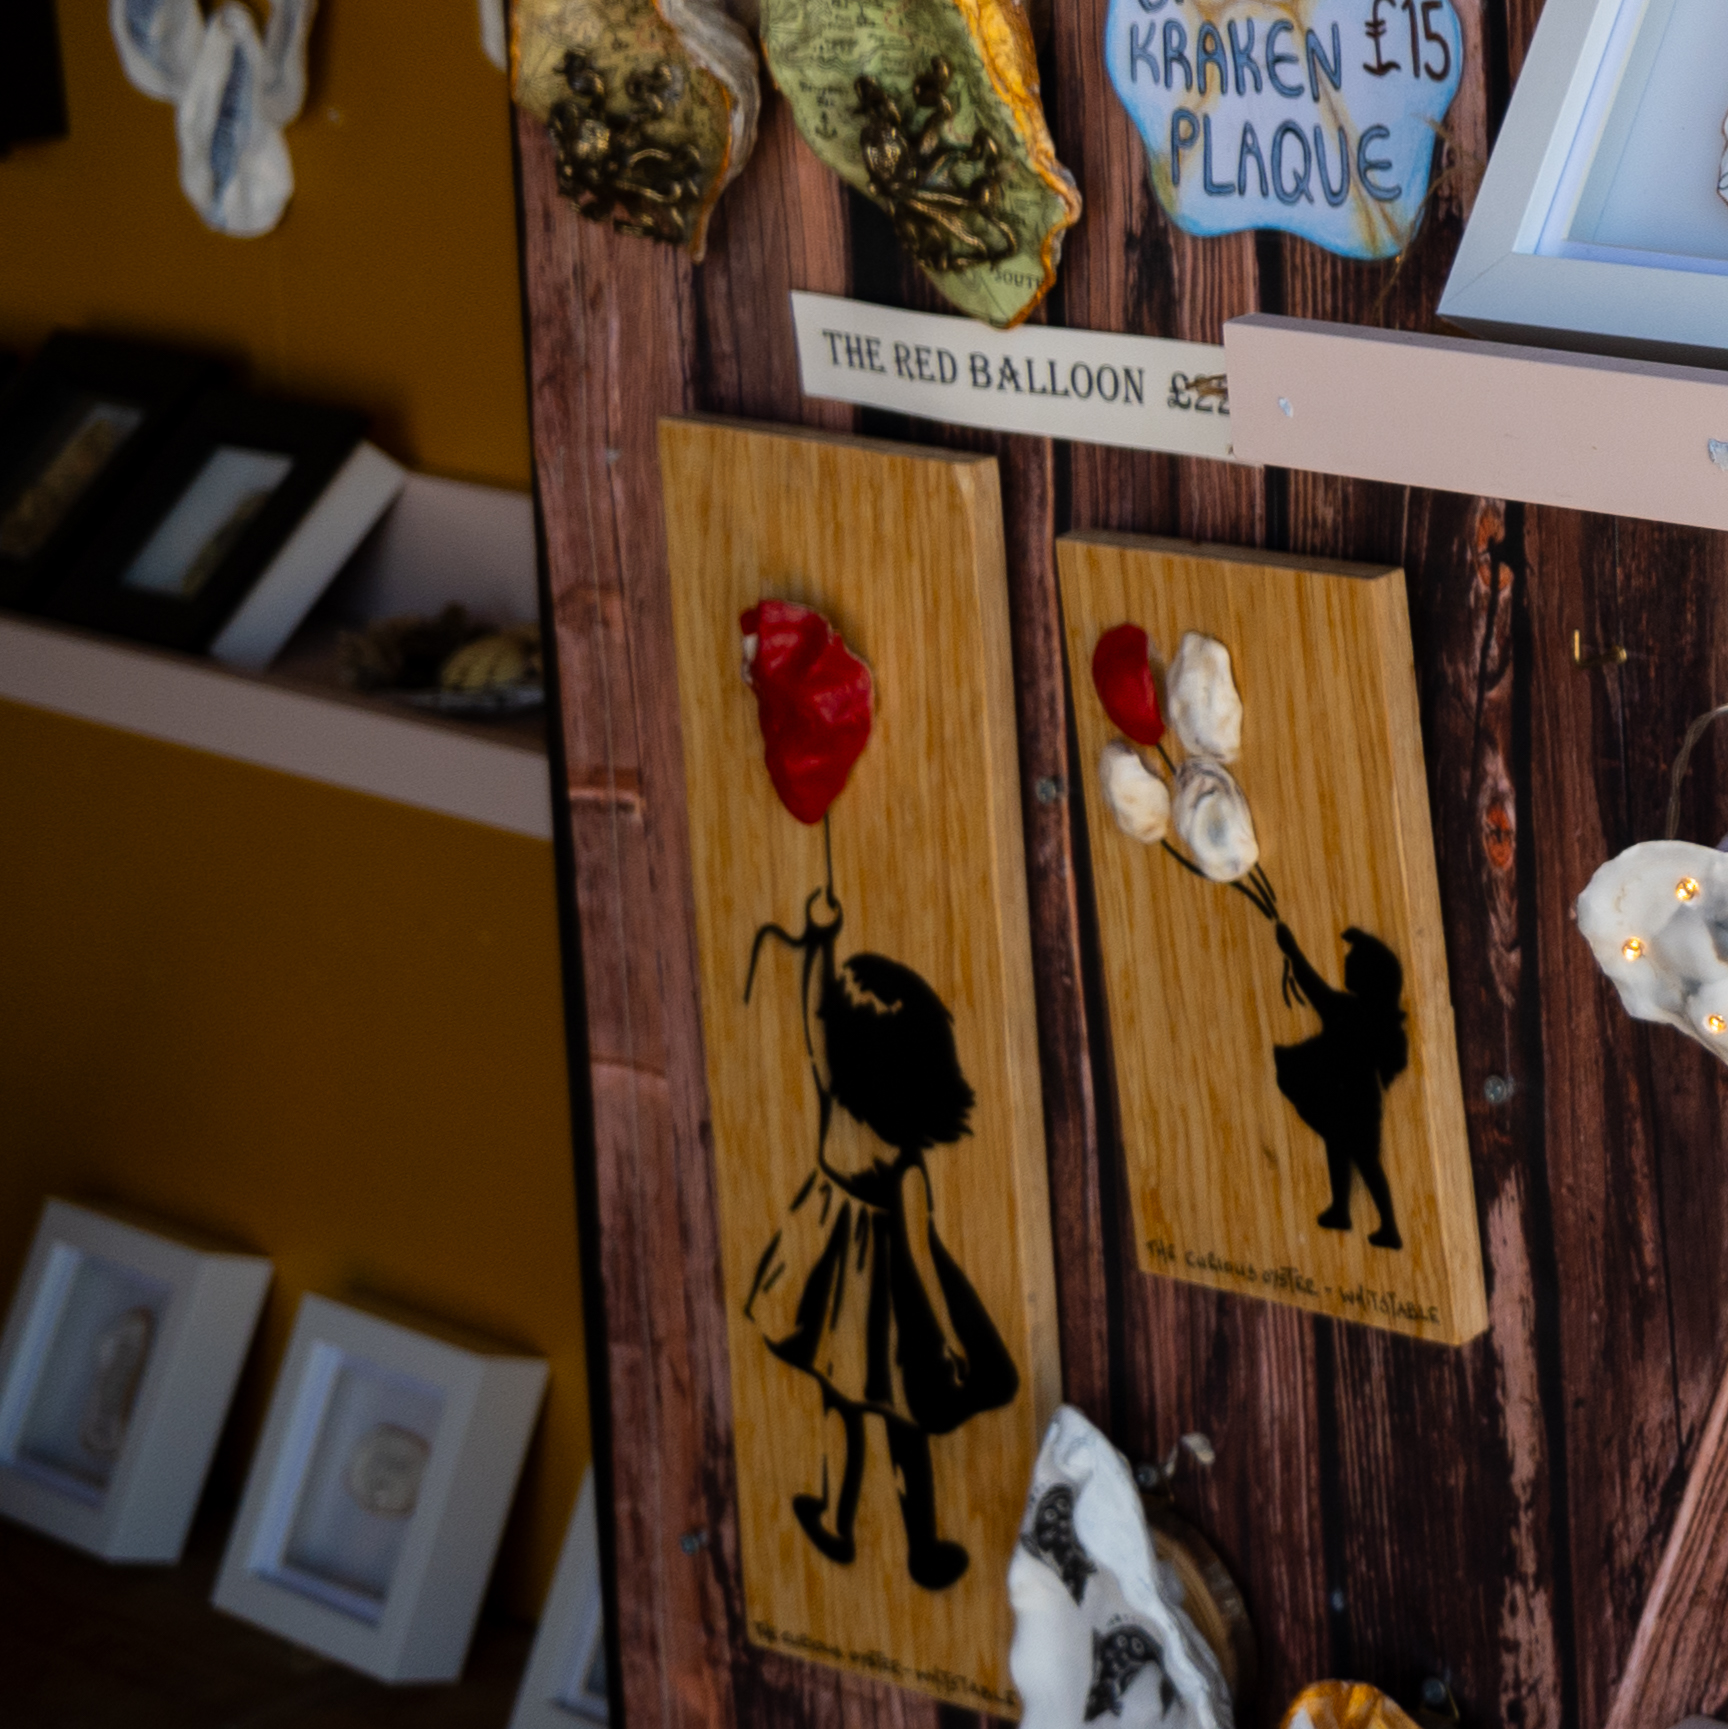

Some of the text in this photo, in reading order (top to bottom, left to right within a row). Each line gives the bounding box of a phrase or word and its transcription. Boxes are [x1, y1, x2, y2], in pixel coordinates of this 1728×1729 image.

[1129, 18, 1343, 103] KRAKEN
[1170, 106, 1403, 207] PLAQUE
[822, 328, 888, 374] THE
[894, 342, 958, 384] RED
[969, 351, 1146, 405] BALLOON
